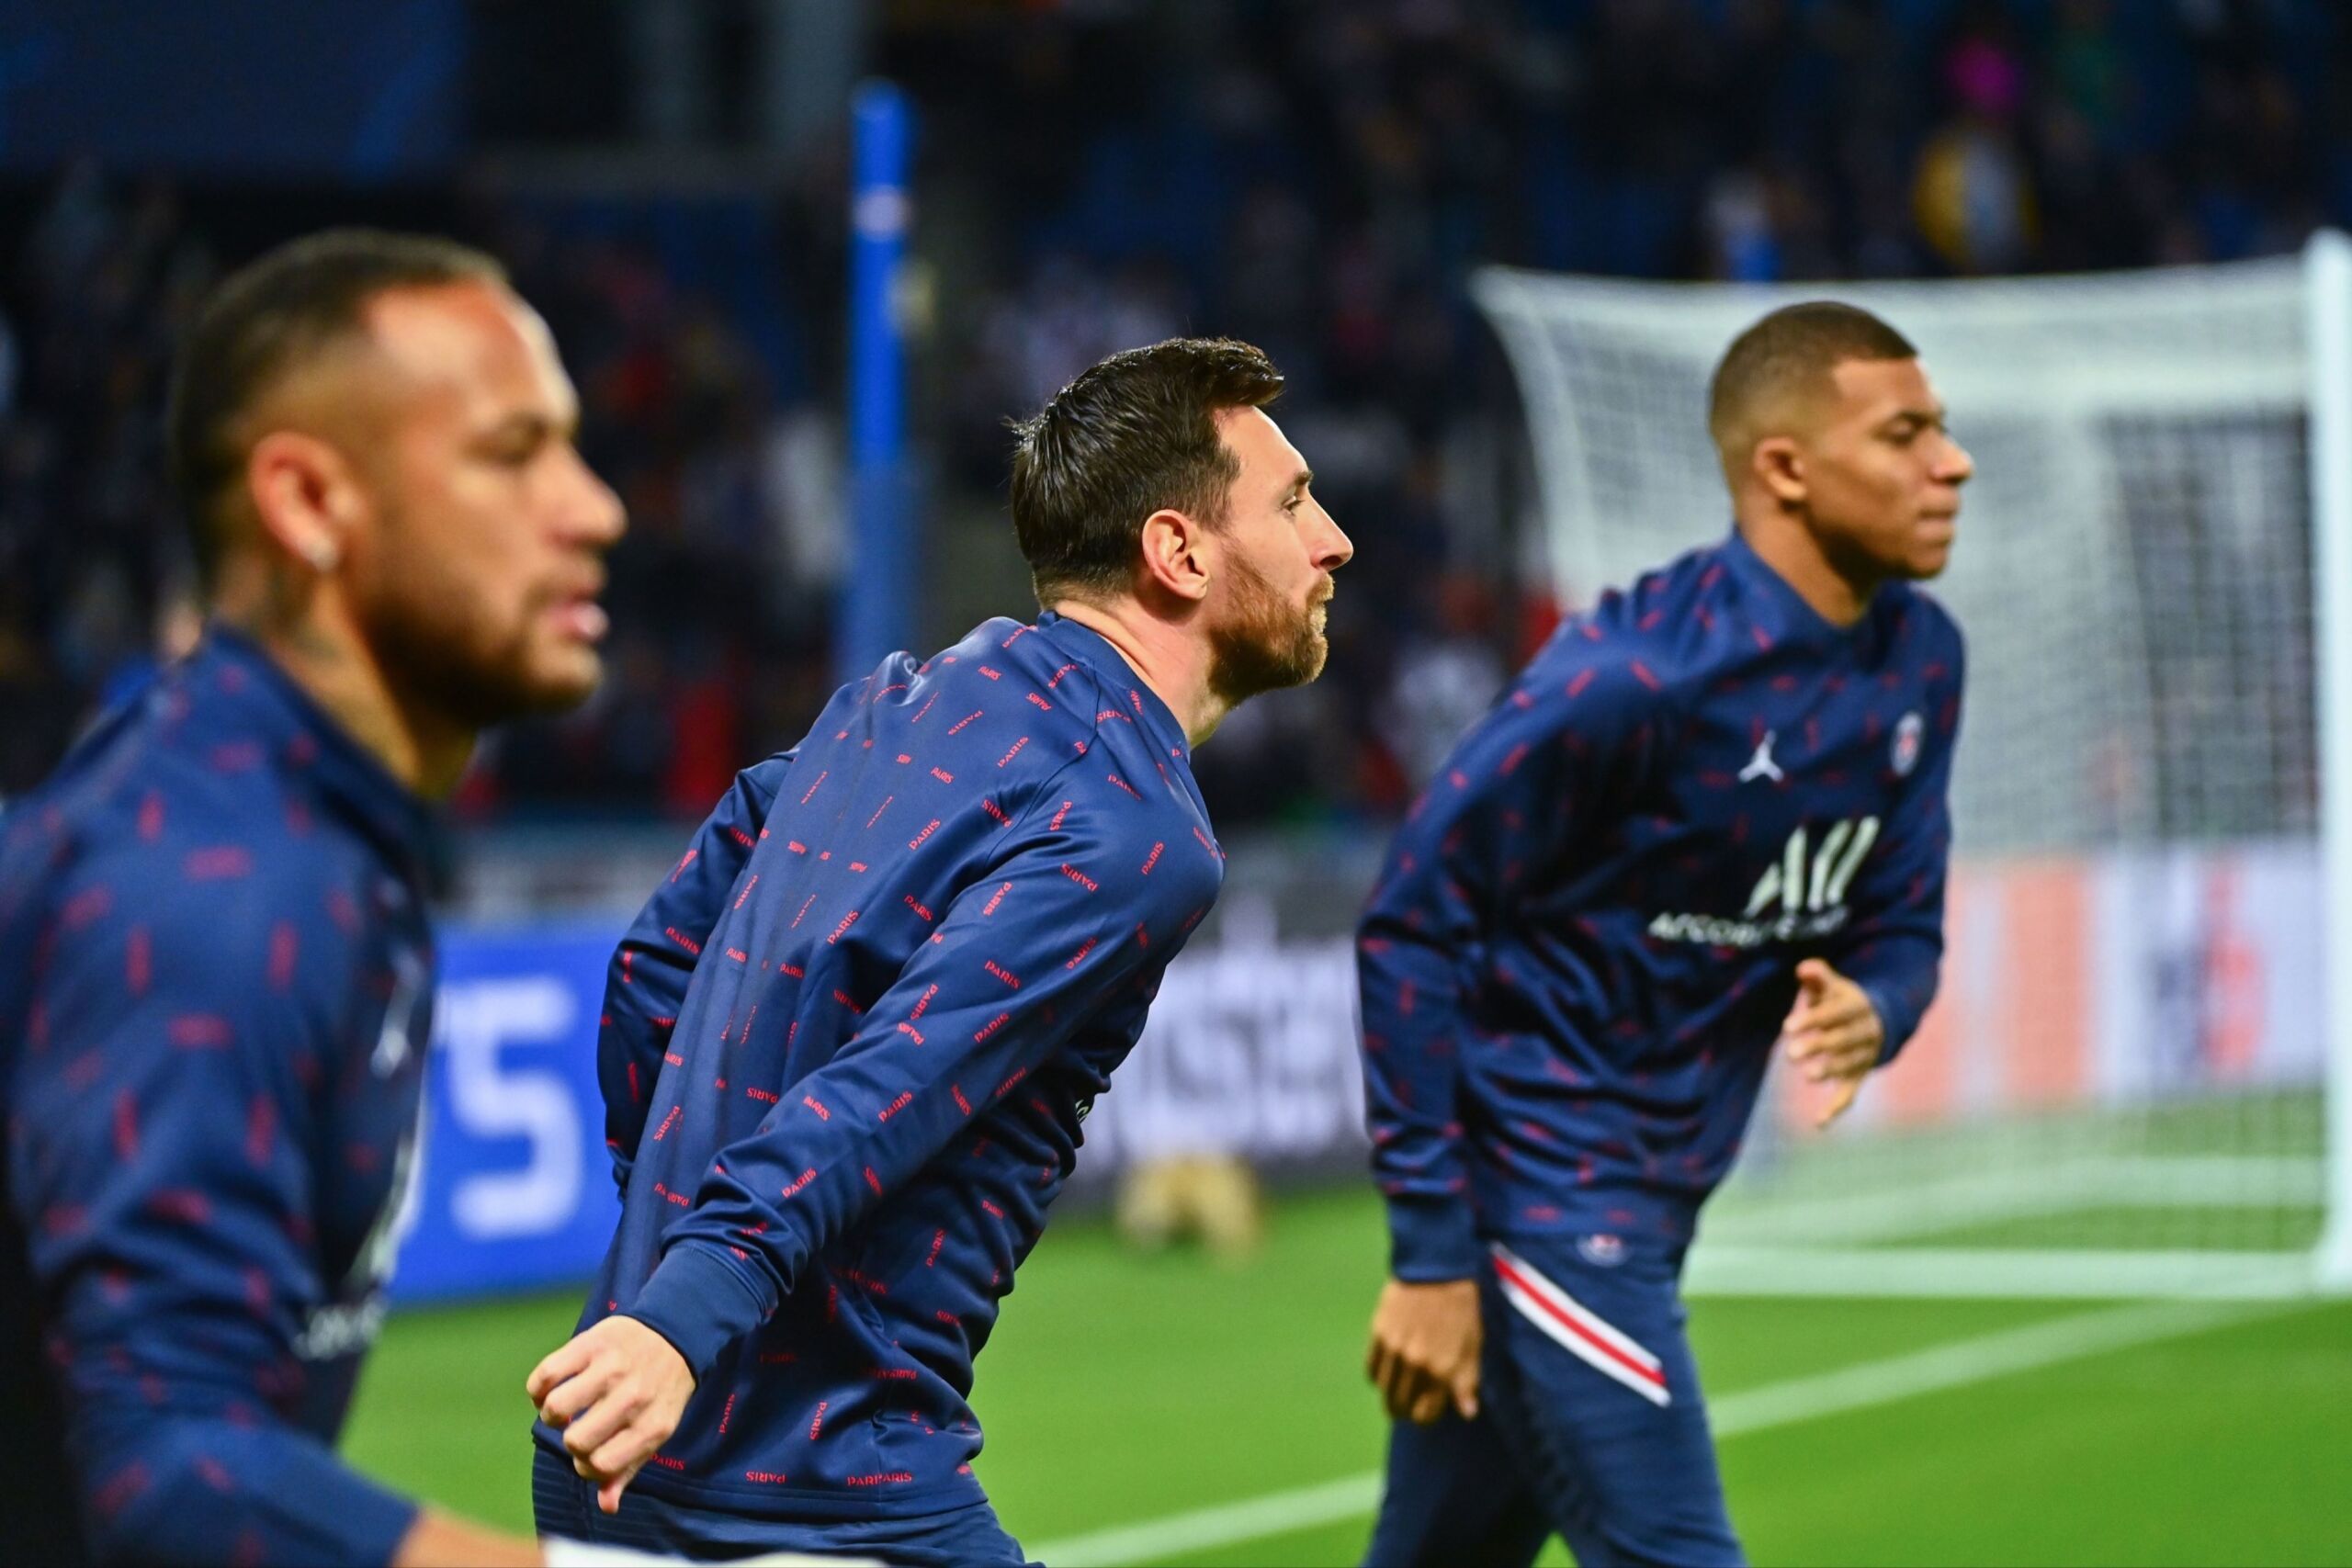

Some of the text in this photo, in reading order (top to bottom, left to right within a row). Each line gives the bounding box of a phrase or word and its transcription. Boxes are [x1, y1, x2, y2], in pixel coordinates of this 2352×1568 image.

[1026, 692, 1052, 711] PARIS
[999, 737, 1029, 767] PARIS
[931, 767, 955, 784] PARIS
[982, 799, 1012, 828] PARIS
[1049, 801, 1073, 831] PARIS
[910, 818, 941, 850] PARIS
[1141, 841, 1165, 874] PARIS
[1060, 863, 1099, 891] PARIS
[984, 882, 1012, 916] PARIS
[665, 927, 700, 954] PARIS
[828, 910, 859, 944] PARIS
[727, 948, 748, 963] PARIS
[1066, 939, 1096, 969] PARIS
[780, 963, 804, 979] PARIS
[984, 960, 1021, 989] PARIS
[910, 984, 939, 1021] PARIS
[974, 1013, 1009, 1043] PARIS
[435, 974, 583, 1237] 5
[746, 1087, 779, 1103] PARIS
[804, 1096, 831, 1121] PARIS
[878, 1091, 913, 1122] PARIS
[654, 1105, 680, 1140] PARIS
[782, 1168, 817, 1198] PARIS
[927, 1230, 945, 1267] PARIS
[718, 1393, 736, 1434] PARIS
[808, 1401, 828, 1441] PARIS
[746, 1471, 787, 1484] PARIS
